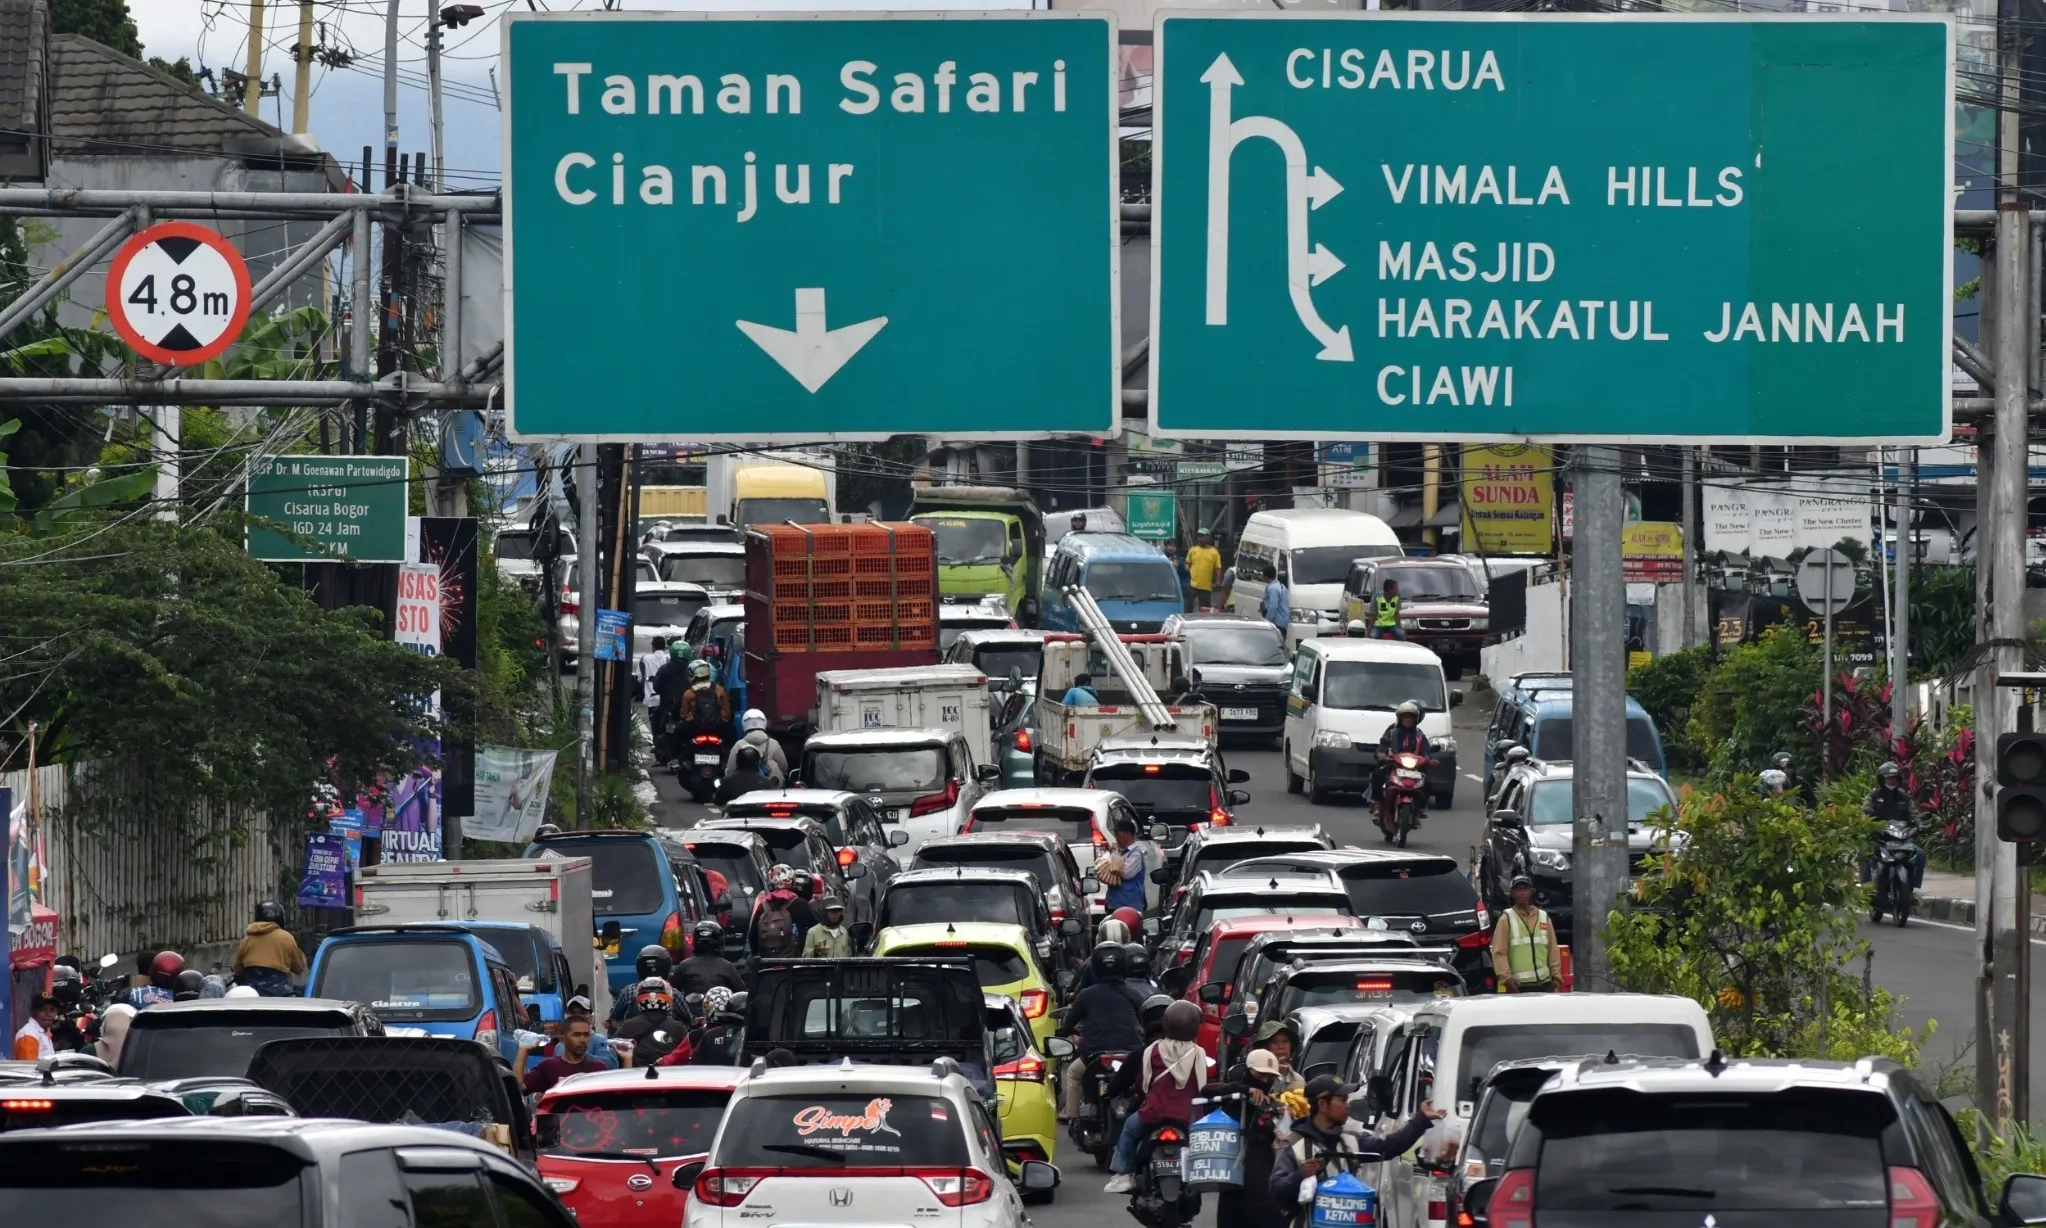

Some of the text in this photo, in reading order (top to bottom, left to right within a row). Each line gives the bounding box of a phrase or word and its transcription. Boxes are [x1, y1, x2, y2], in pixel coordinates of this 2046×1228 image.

[1286, 48, 1505, 92] CISARUA
[552, 59, 1067, 115] Taman Safari
[554, 151, 855, 224] Cianjur
[1381, 164, 1744, 208] VIMALA HILLS
[1377, 241, 1555, 283] MASJID
[1377, 298, 1906, 344] HARAKATUL JANNAH
[1376, 364, 1514, 406] CIAWI
[276, 464, 290, 476] Dr.
[303, 463, 345, 476] Goenawan
[346, 463, 401, 479] Partowidigdo
[1482, 464, 1535, 482] ALAM
[1472, 486, 1540, 504] SUNDA
[284, 502, 370, 518] Cisarua Bogor
[1493, 509, 1514, 519] Semua
[1515, 510, 1545, 521] Kalangan
[293, 521, 361, 536] IGD 24 Jam
[1835, 517, 1863, 525] Cluster
[329, 541, 348, 555] KM
[1849, 653, 1873, 662] 7099
[864, 712, 881, 722] ICC
[942, 706, 959, 715] ICC
[381, 829, 440, 852] VIRTUAL
[1325, 1210, 1357, 1222] KETAN
